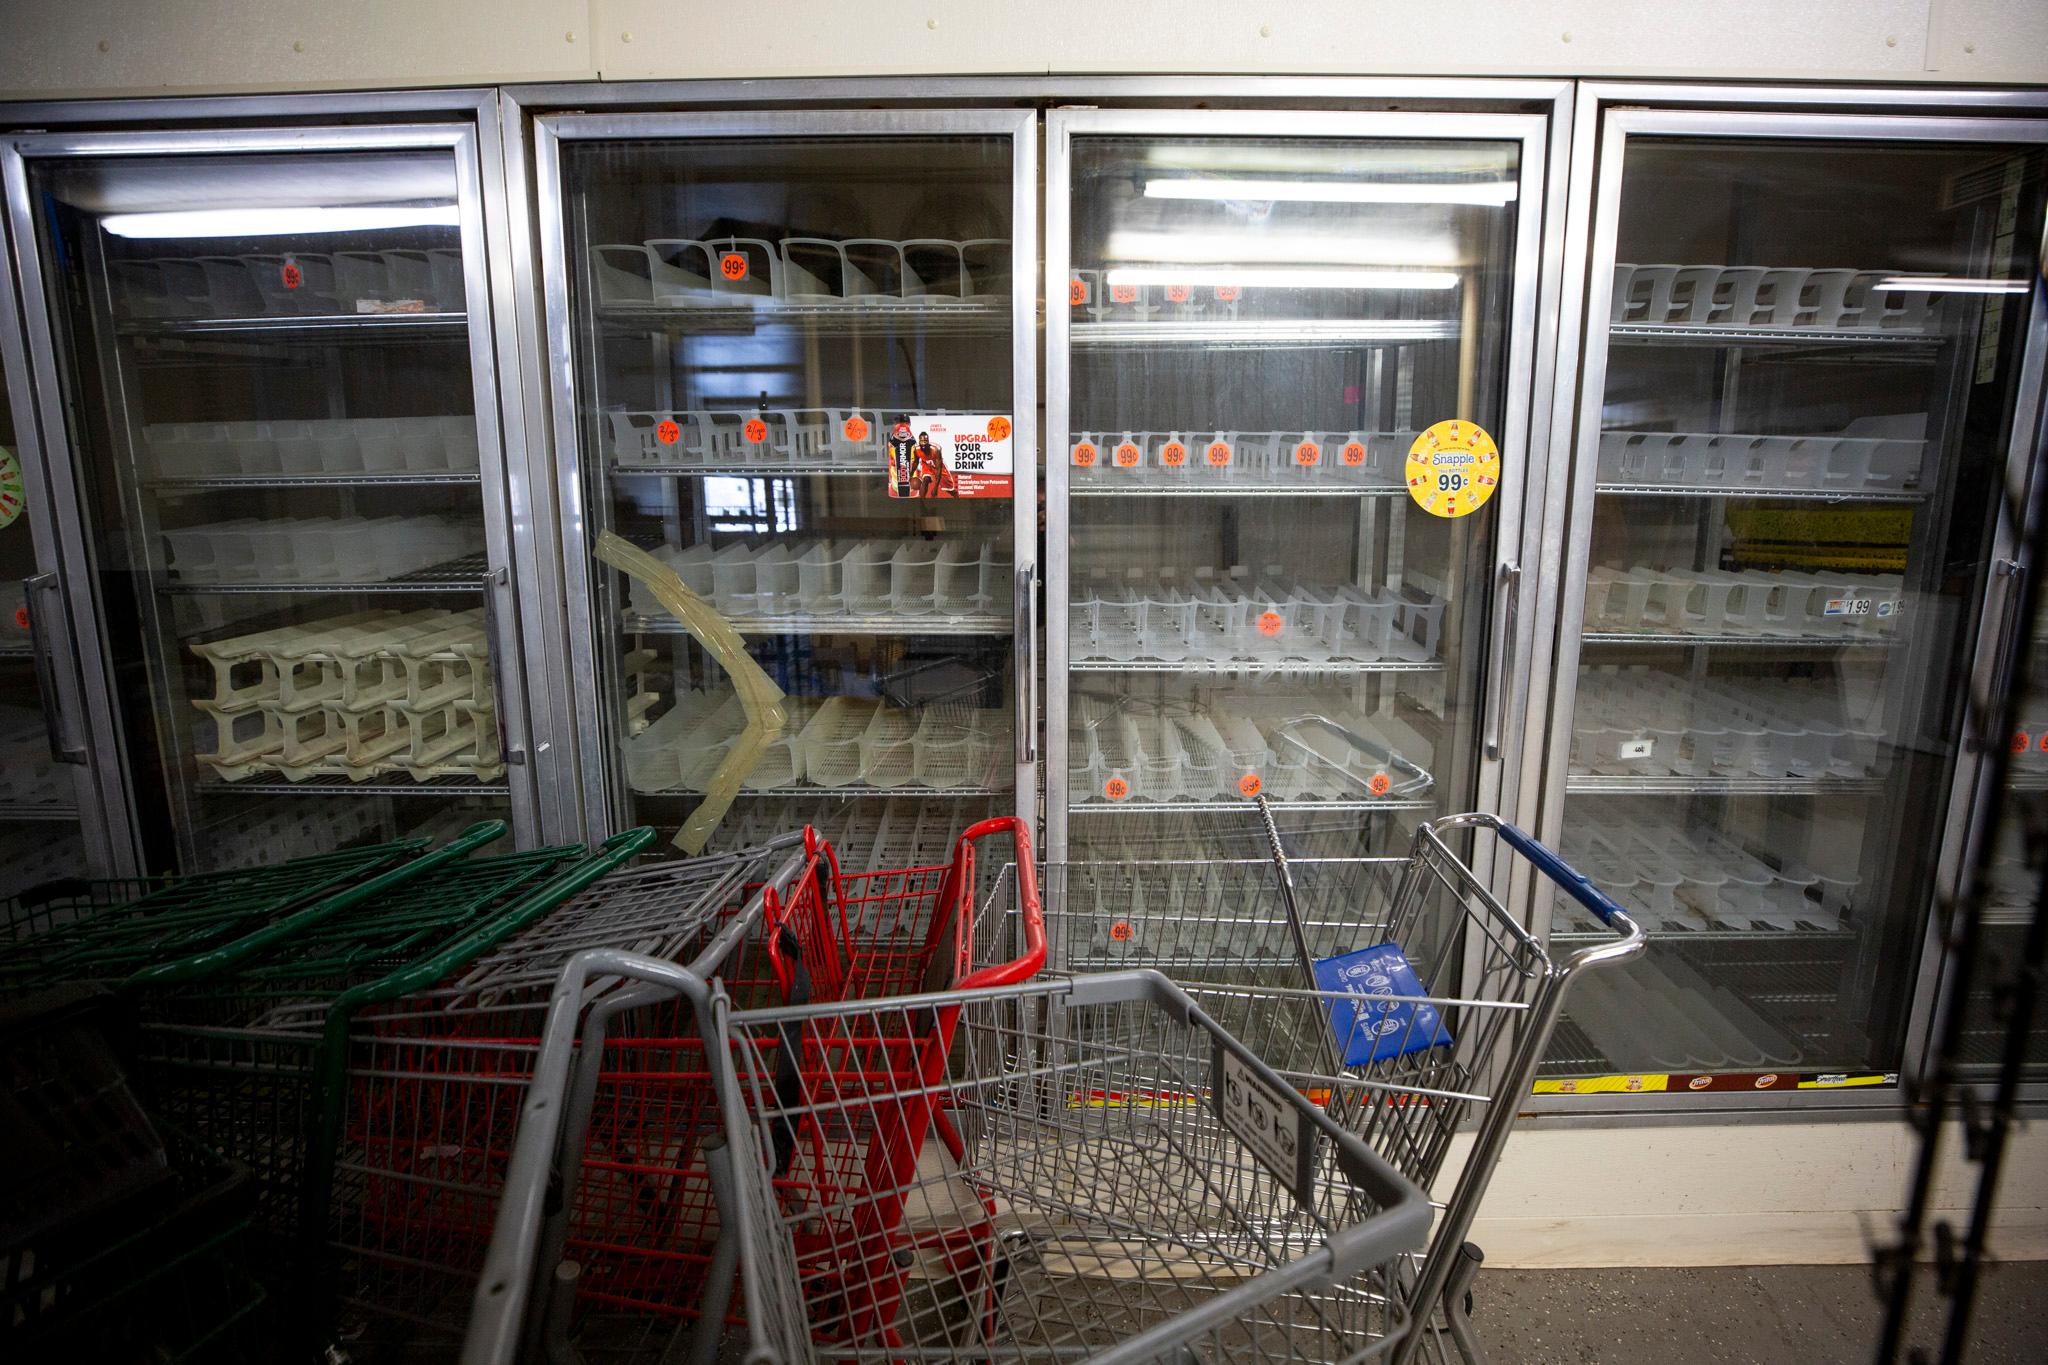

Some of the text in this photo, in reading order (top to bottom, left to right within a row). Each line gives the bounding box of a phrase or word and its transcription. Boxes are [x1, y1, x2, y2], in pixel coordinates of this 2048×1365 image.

[725, 260, 744, 275] 99¢
[954, 434, 999, 443] UPGRAD
[954, 443, 981, 452] YOUR
[955, 452, 994, 461] SPORTS
[1432, 453, 1475, 467] Snapple
[955, 461, 985, 470] DRINK
